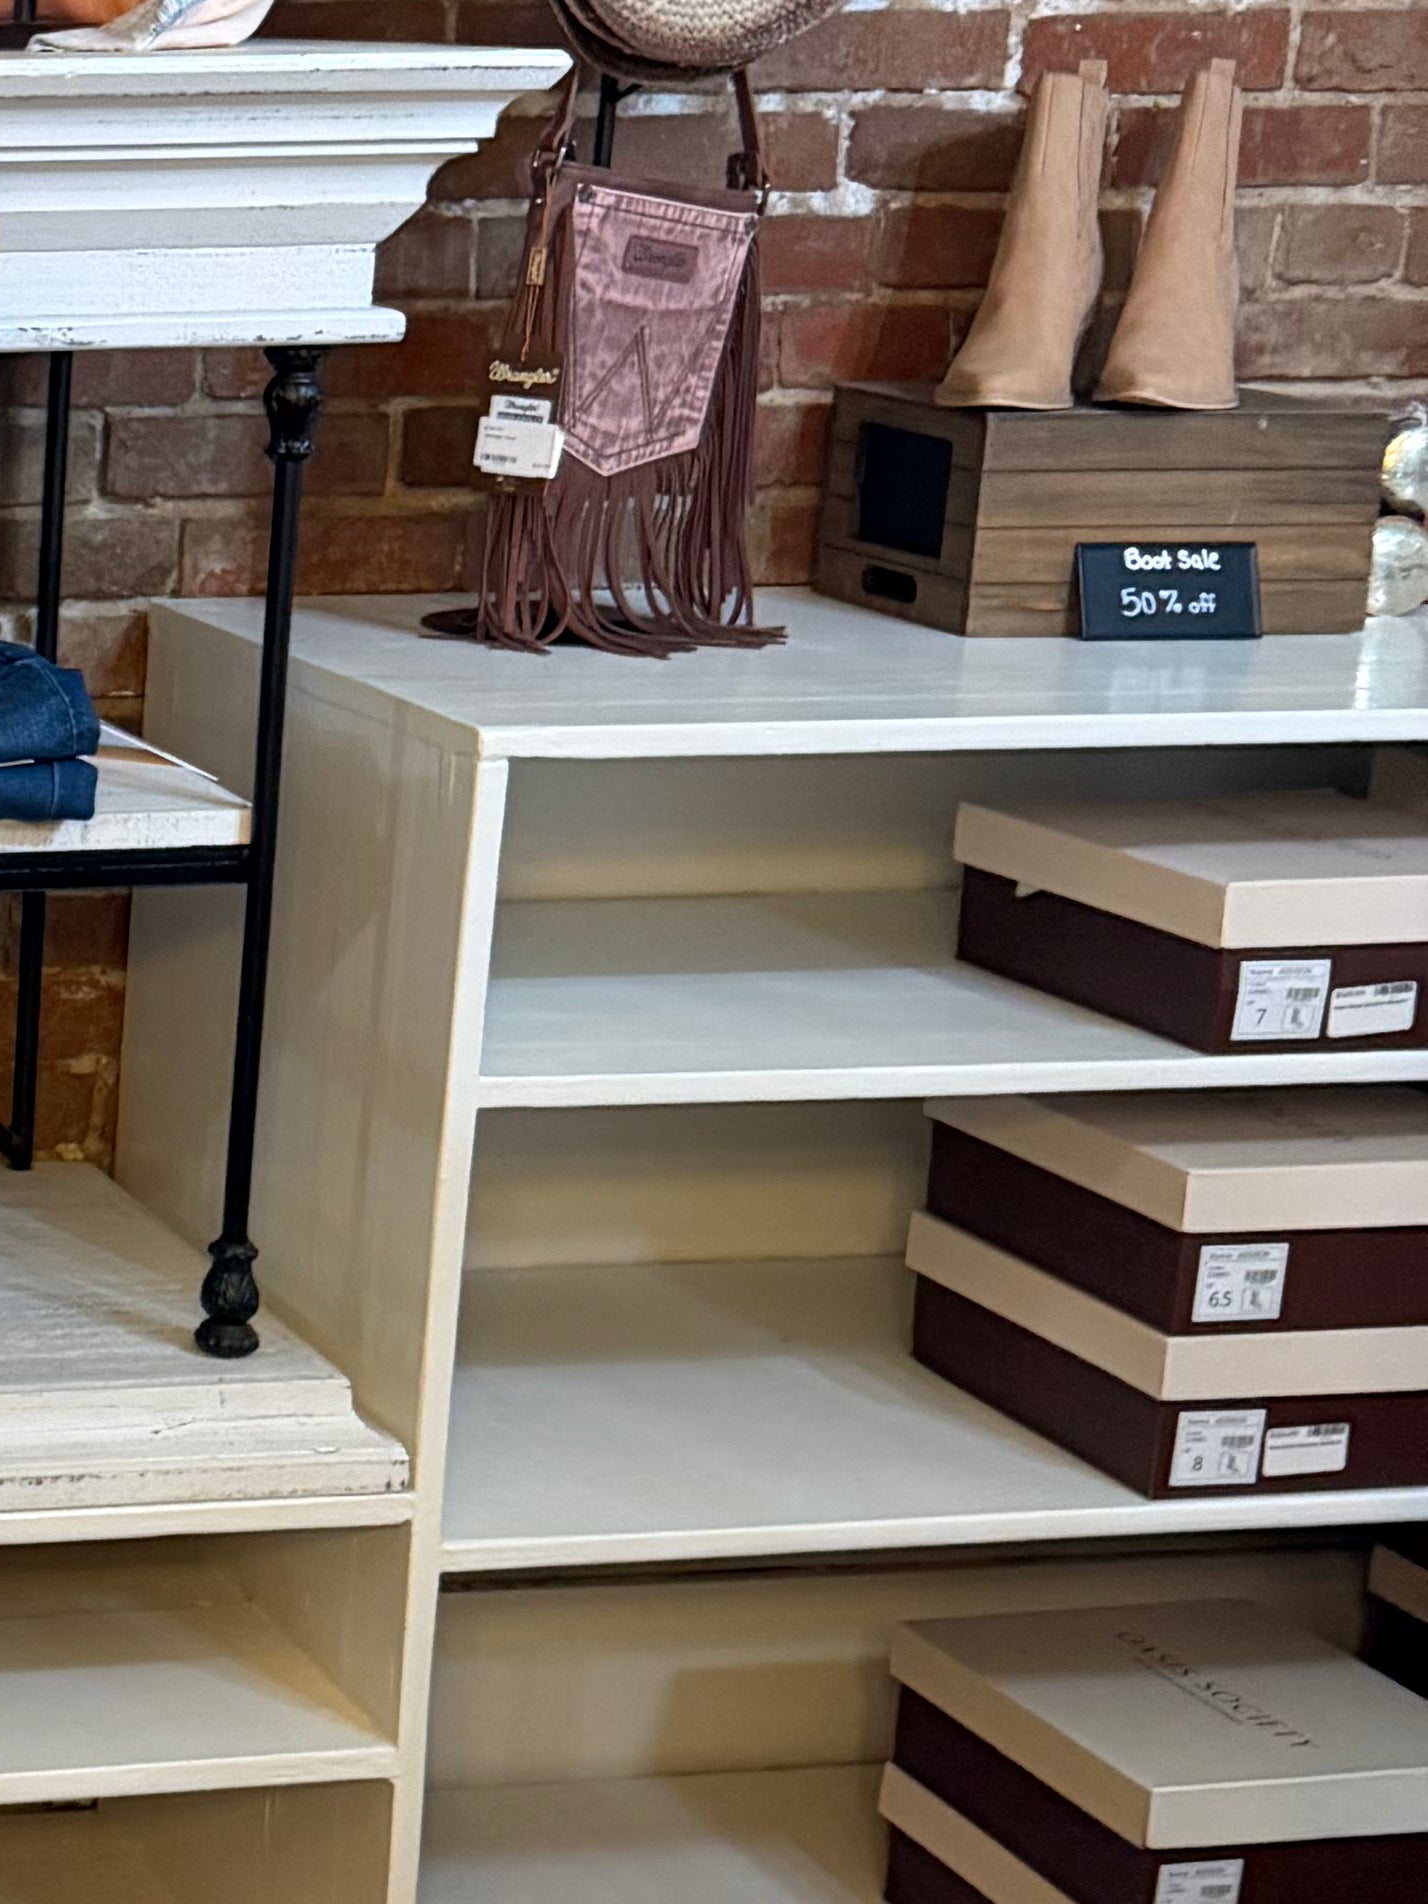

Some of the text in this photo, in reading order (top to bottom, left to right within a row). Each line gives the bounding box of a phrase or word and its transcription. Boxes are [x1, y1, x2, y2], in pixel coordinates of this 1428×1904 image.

[1123, 546, 1222, 571] Boot Sale
[1120, 587, 1217, 617] 50% off
[1254, 1007, 1268, 1026] 7
[1191, 1455, 1204, 1472] 8
